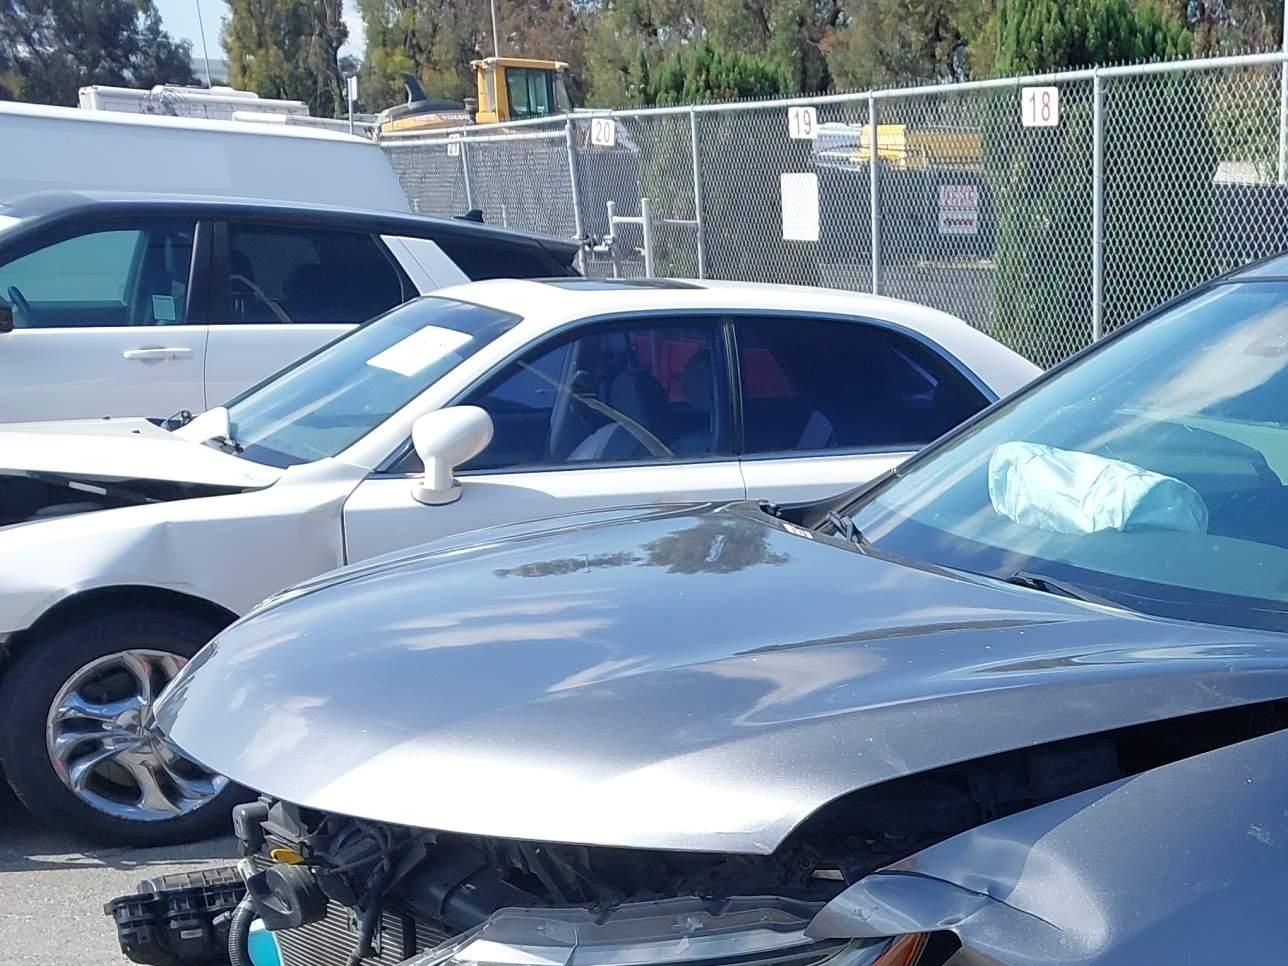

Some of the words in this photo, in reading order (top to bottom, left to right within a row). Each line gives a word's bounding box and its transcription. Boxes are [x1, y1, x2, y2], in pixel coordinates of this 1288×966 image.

[1028, 90, 1051, 122] 18
[595, 121, 611, 143] 20
[794, 110, 812, 135] 19
